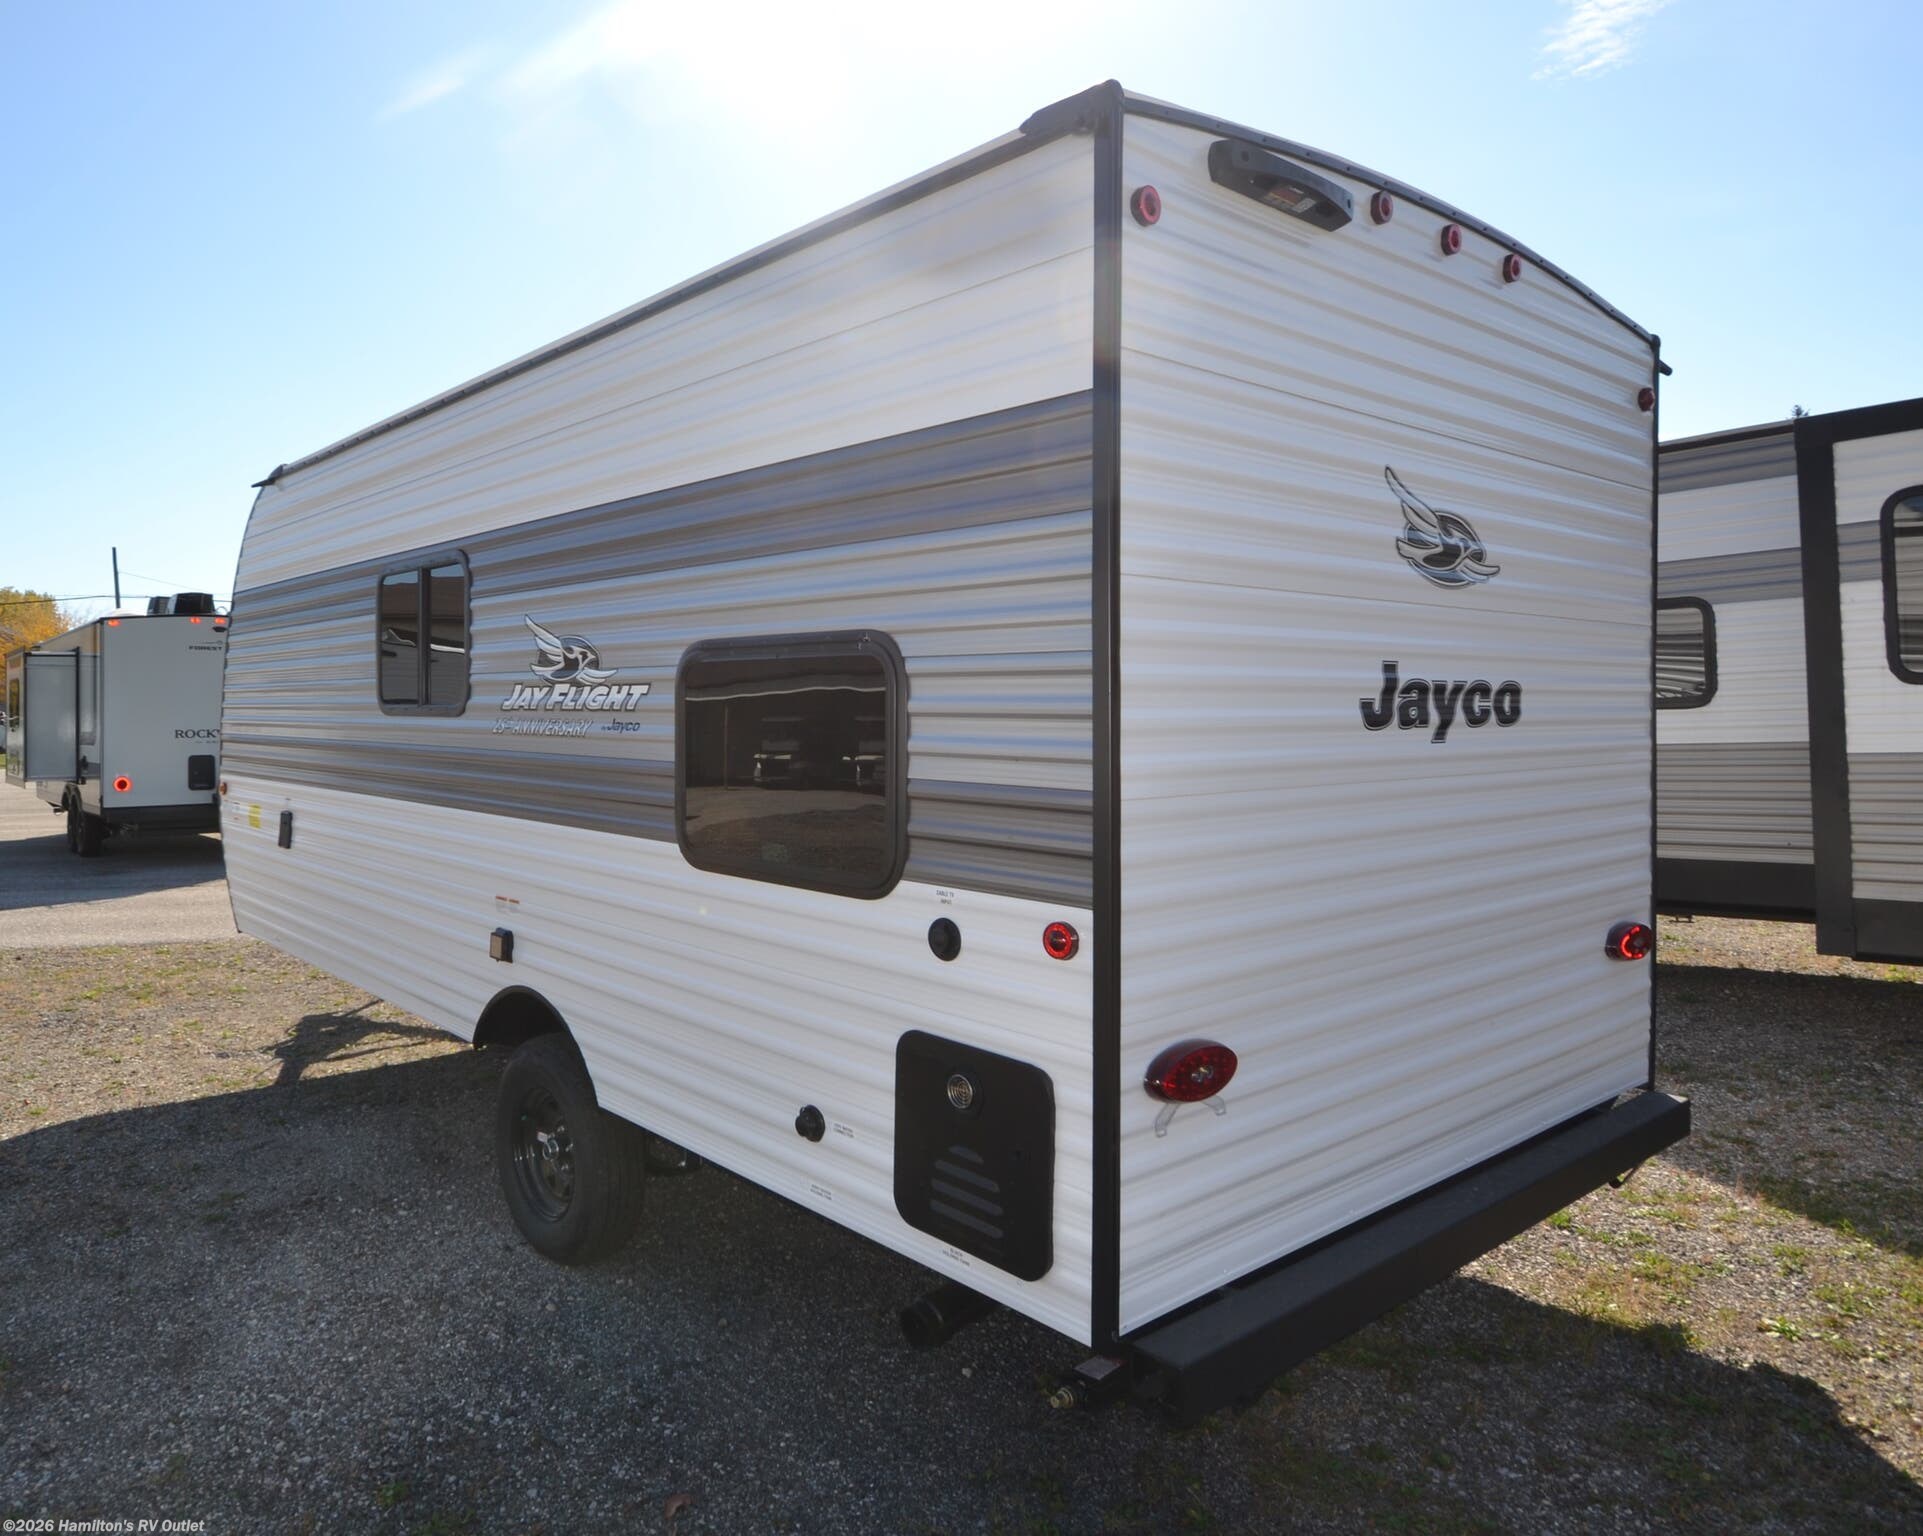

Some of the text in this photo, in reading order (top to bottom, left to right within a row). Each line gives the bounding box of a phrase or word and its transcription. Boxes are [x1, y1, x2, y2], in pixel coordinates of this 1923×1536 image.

[502, 683, 651, 712] JAY FLIGHT
[1360, 660, 1522, 743] Jayco
[512, 718, 594, 738] ANNIVERSARY
[607, 718, 641, 734] Jayco
